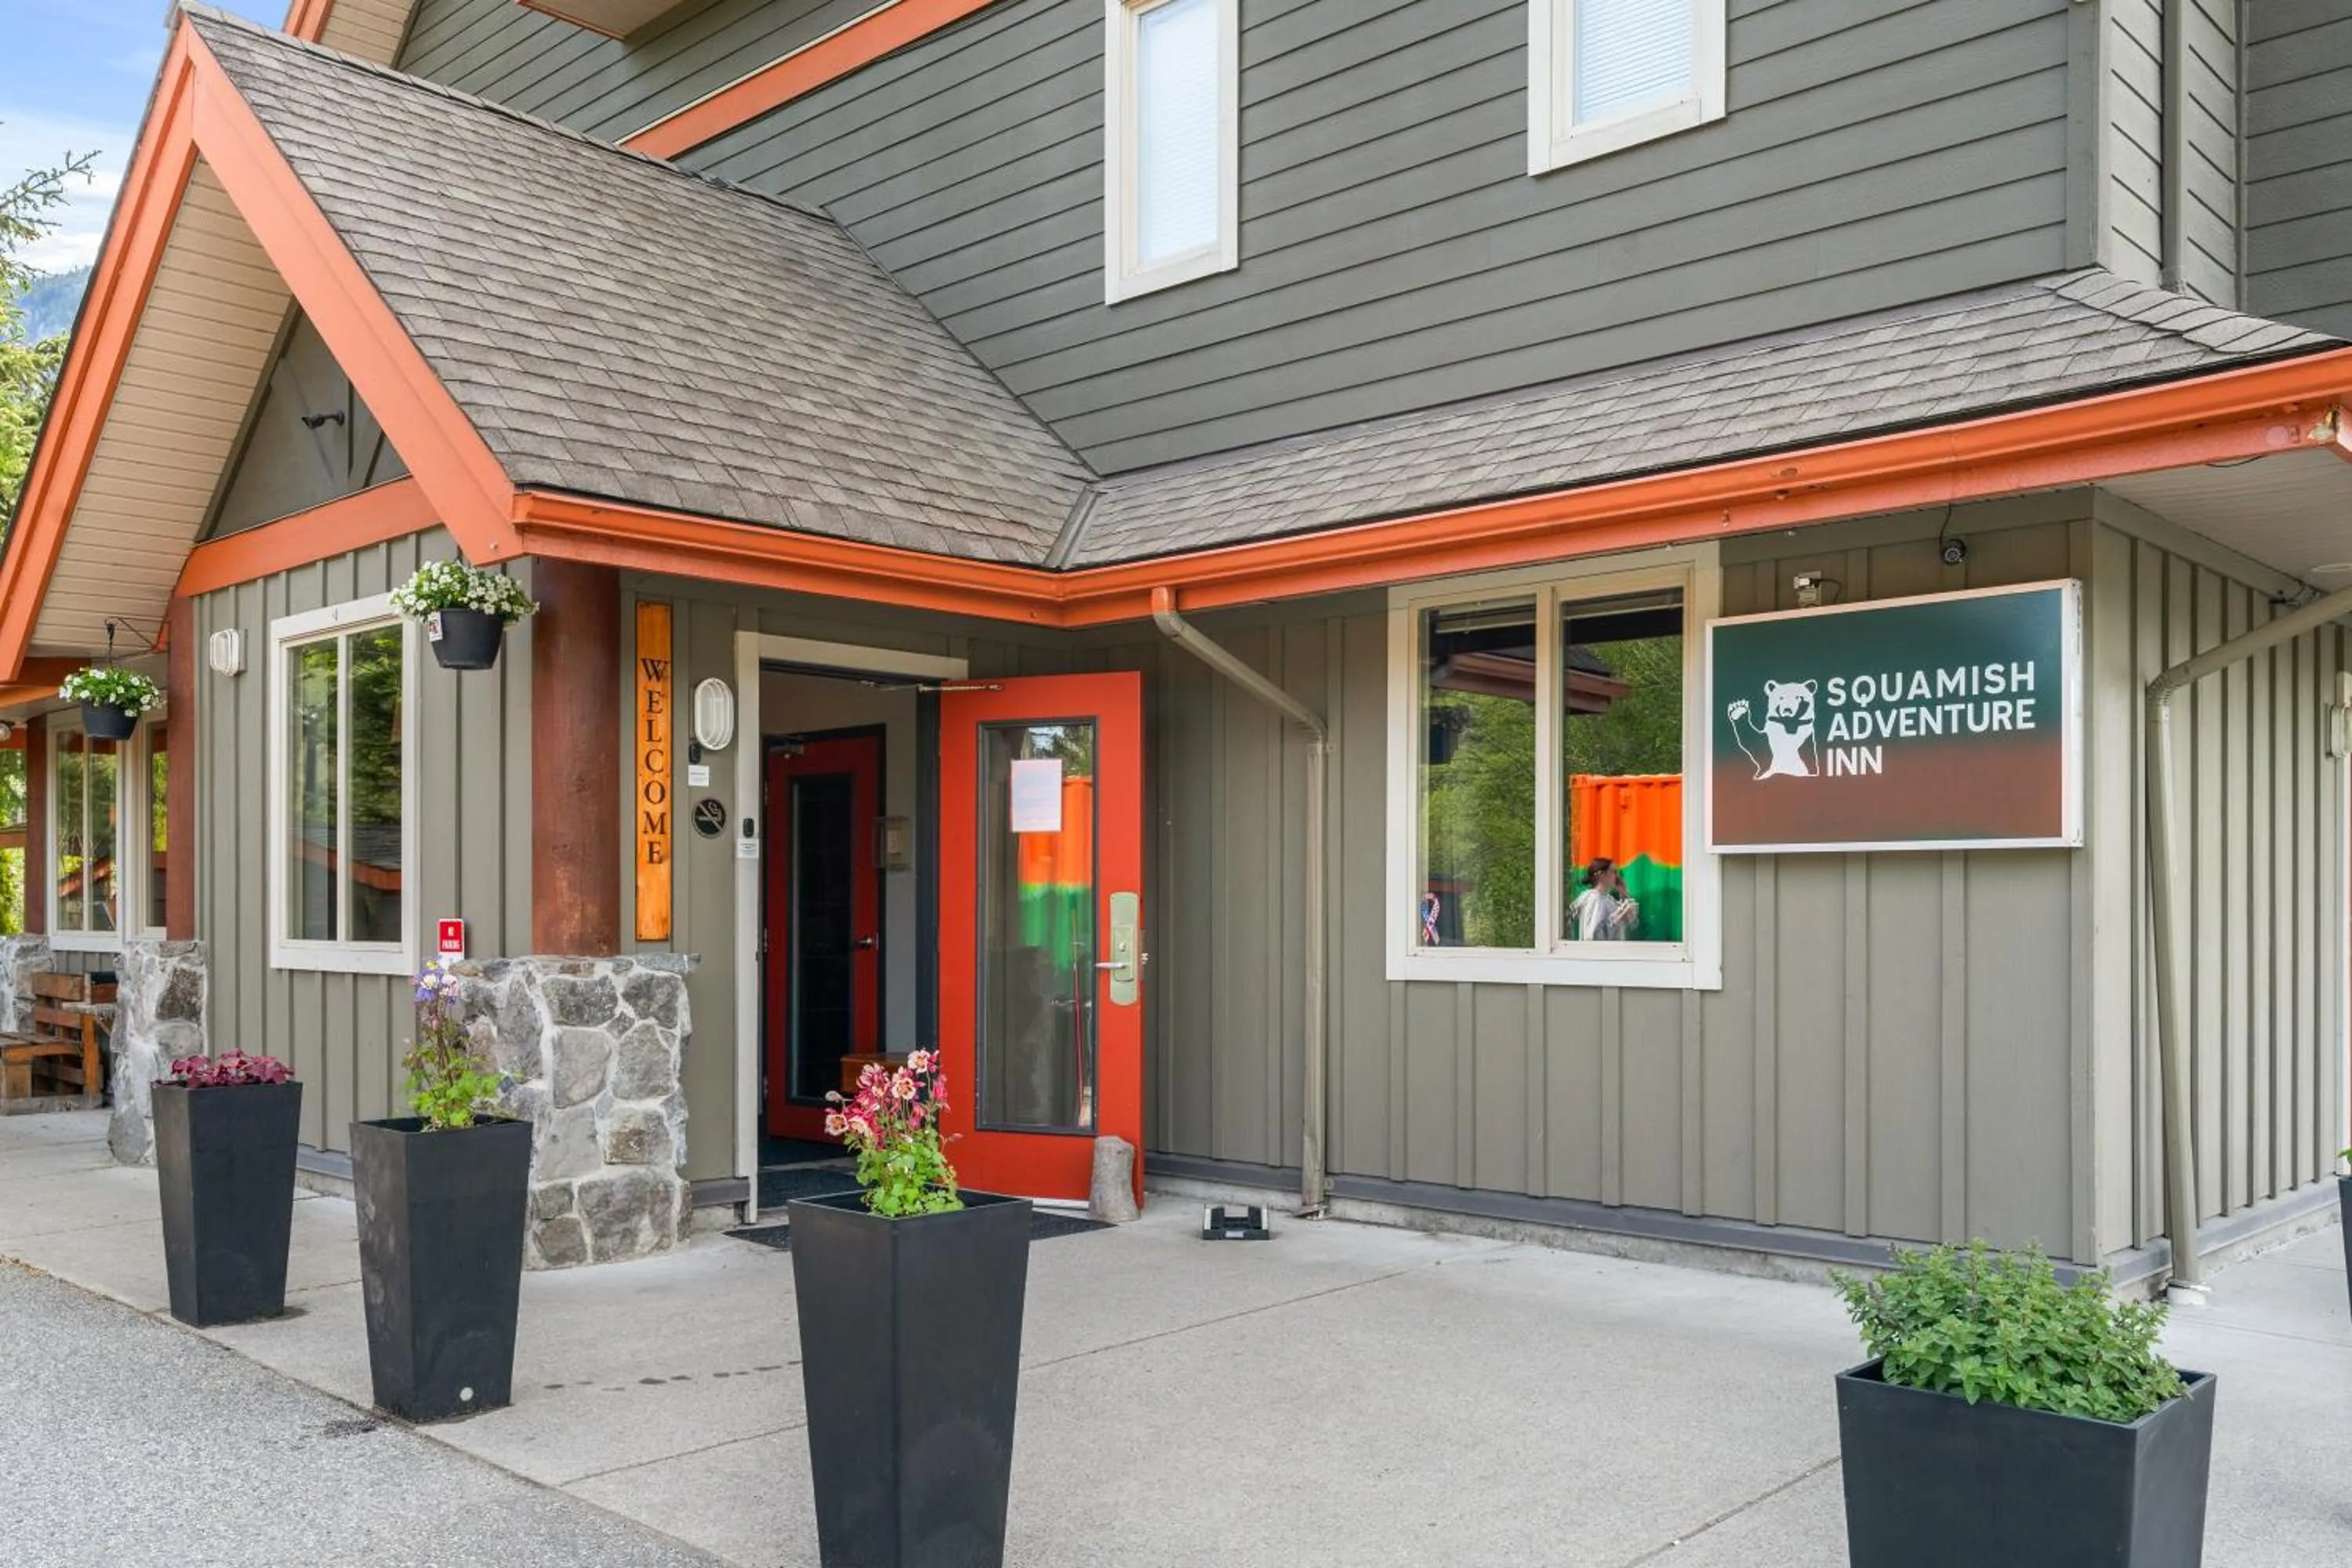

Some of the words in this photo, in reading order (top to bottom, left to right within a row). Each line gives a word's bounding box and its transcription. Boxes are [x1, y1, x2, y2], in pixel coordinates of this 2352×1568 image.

[1827, 661, 2035, 708] SQUAMISH
[1827, 699, 2036, 742] ADVENTURE
[641, 658, 670, 865] WELCOME
[1827, 746, 1882, 777] INN
